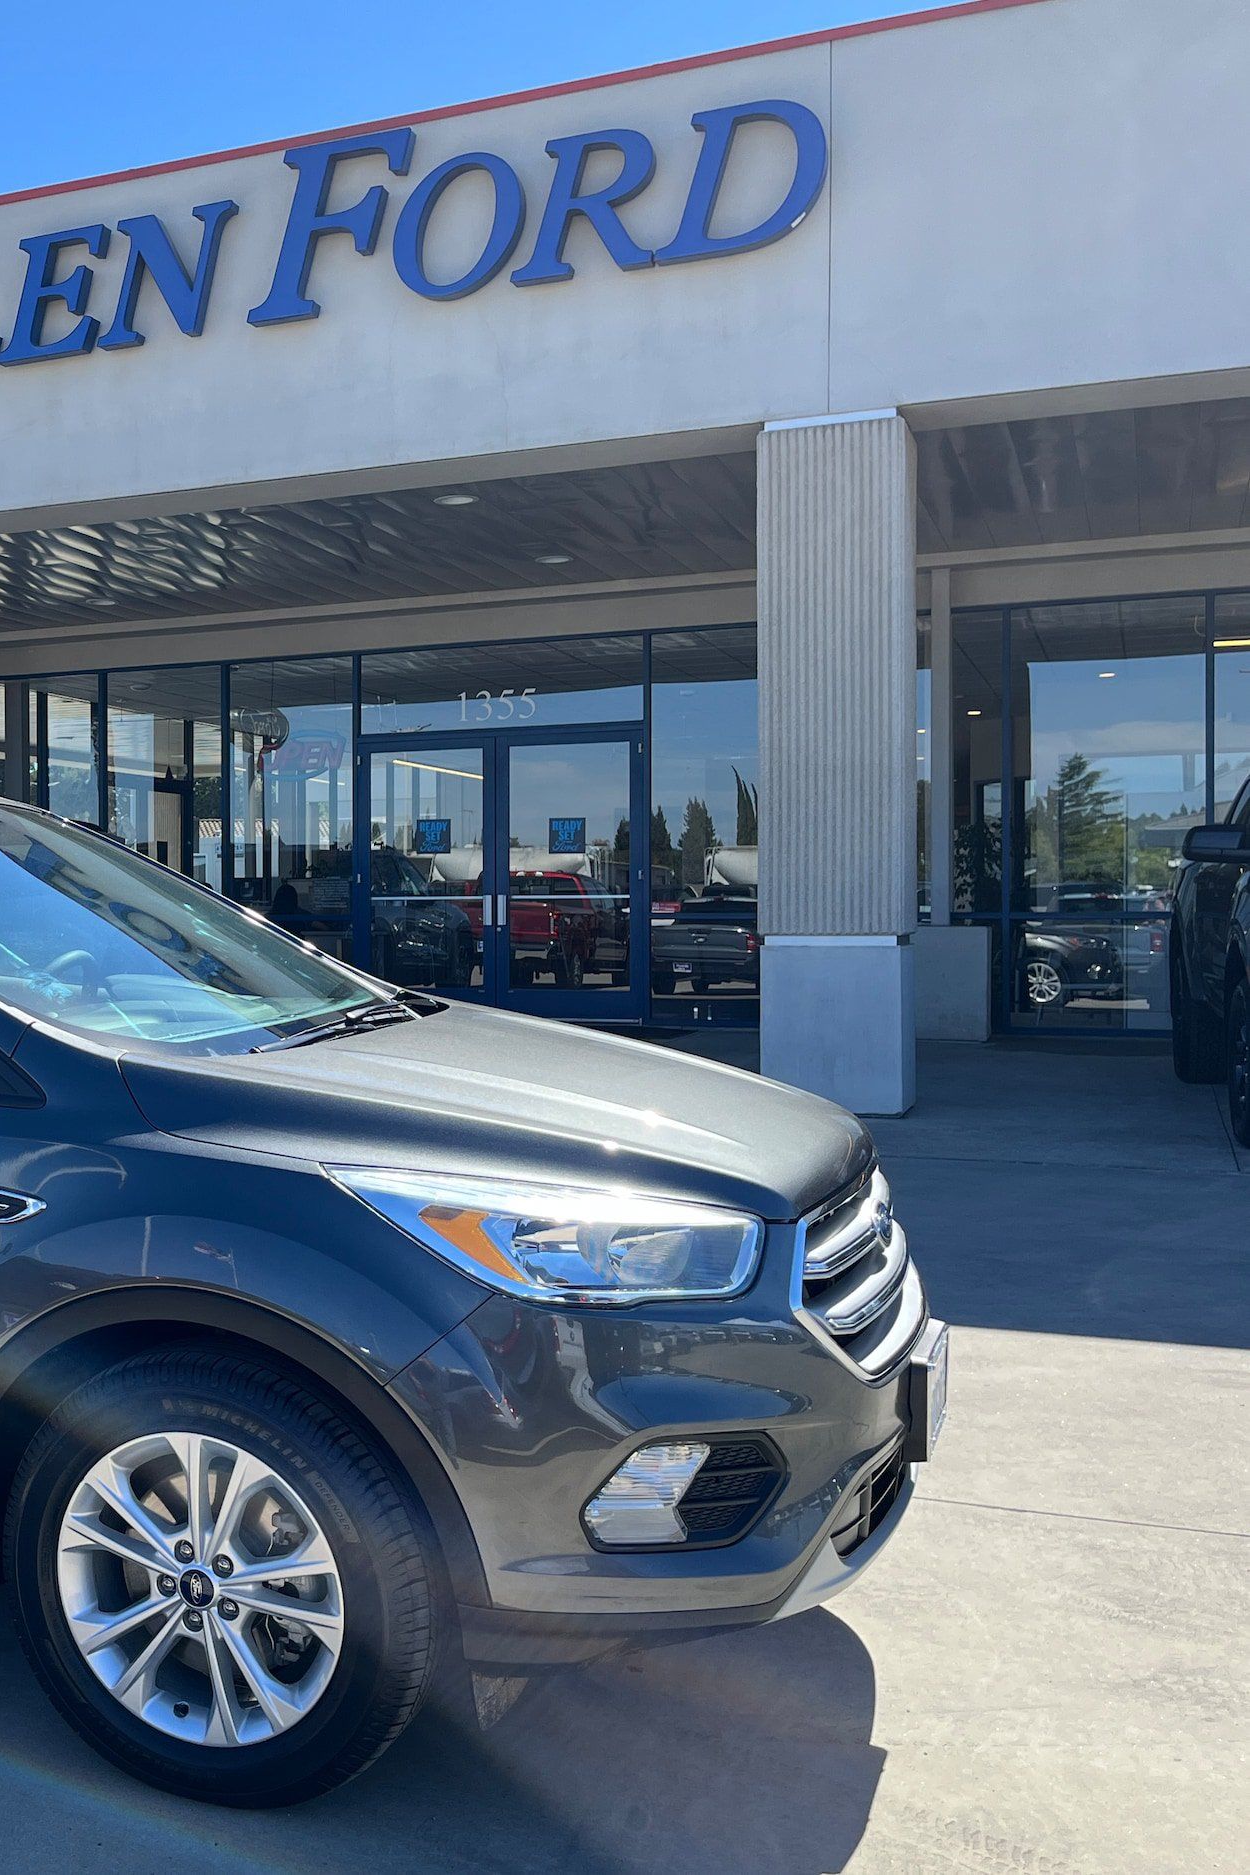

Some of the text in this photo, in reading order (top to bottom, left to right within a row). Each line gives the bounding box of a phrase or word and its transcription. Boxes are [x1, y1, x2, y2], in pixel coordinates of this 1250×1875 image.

[247, 99, 828, 327] FORD
[457, 687, 536, 721] 1355
[420, 821, 447, 832] READY
[425, 832, 440, 841] SET
[552, 820, 582, 831] READY
[558, 831, 575, 841] SET
[201, 1405, 307, 1469] MICHELIN
[314, 1481, 350, 1531] DEFENDER
